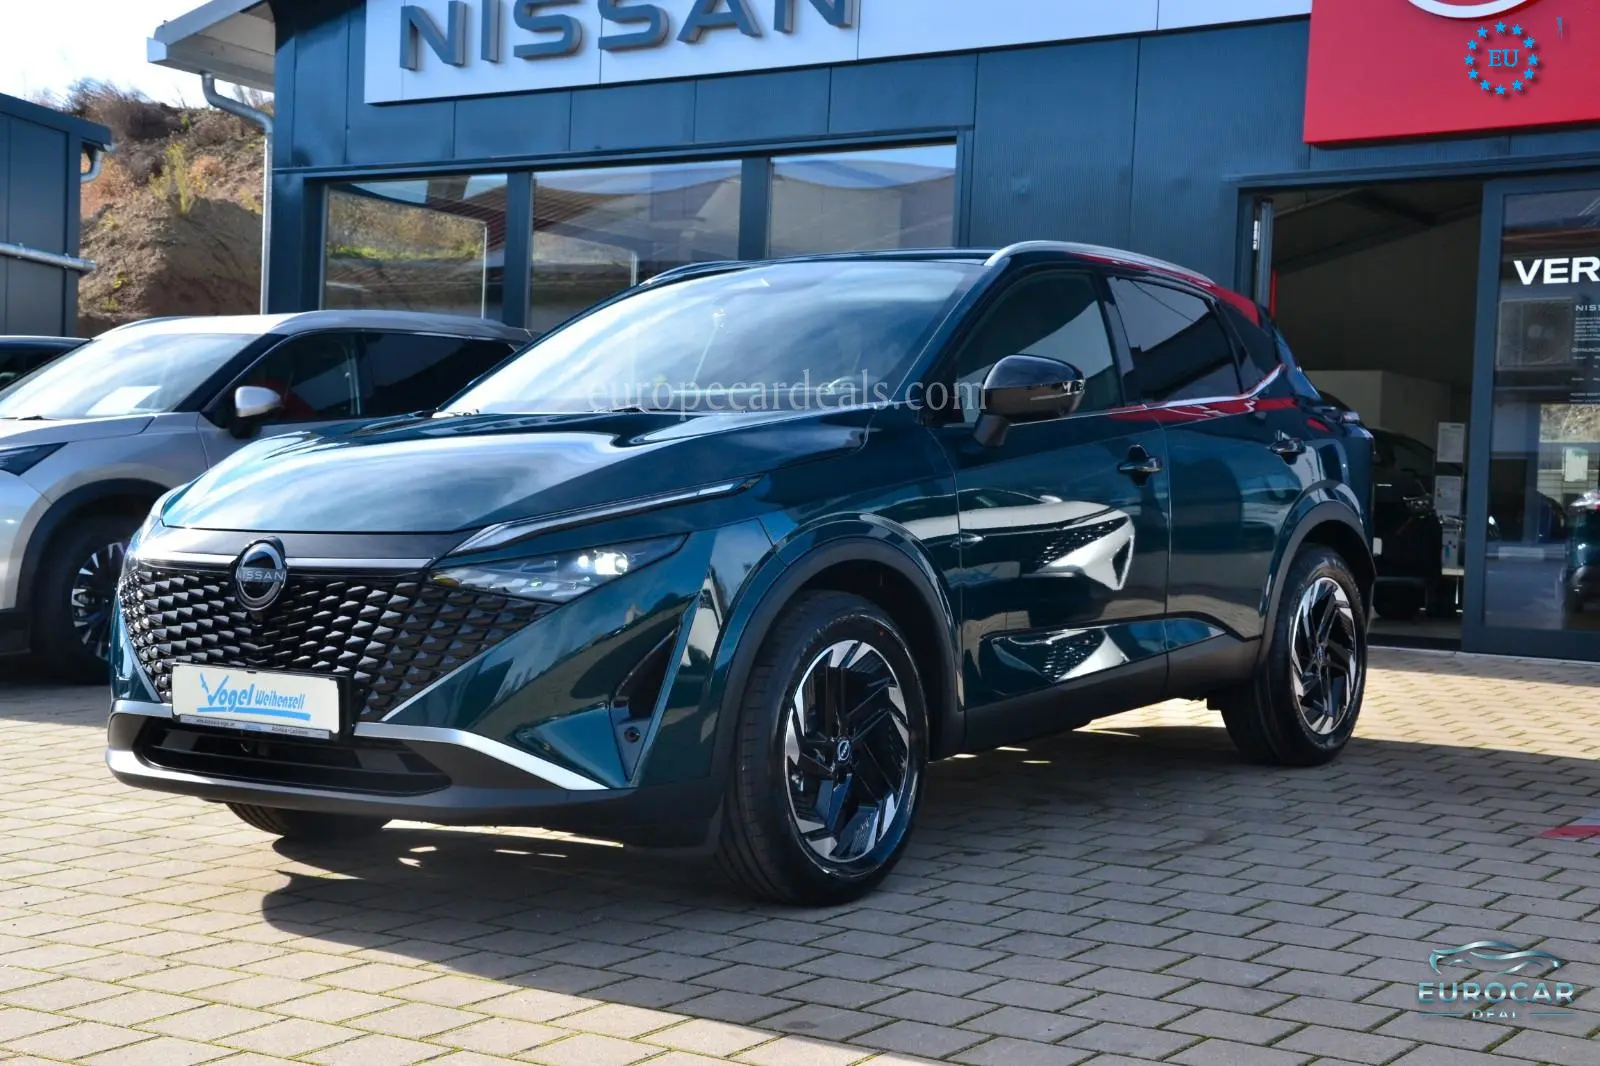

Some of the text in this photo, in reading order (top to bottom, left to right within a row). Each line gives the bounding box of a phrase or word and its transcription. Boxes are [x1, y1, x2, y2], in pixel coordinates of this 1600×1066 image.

[1513, 256, 1600, 285] VER
[236, 568, 284, 581] NISSAN
[199, 671, 306, 712] Vogel Weihenzell
